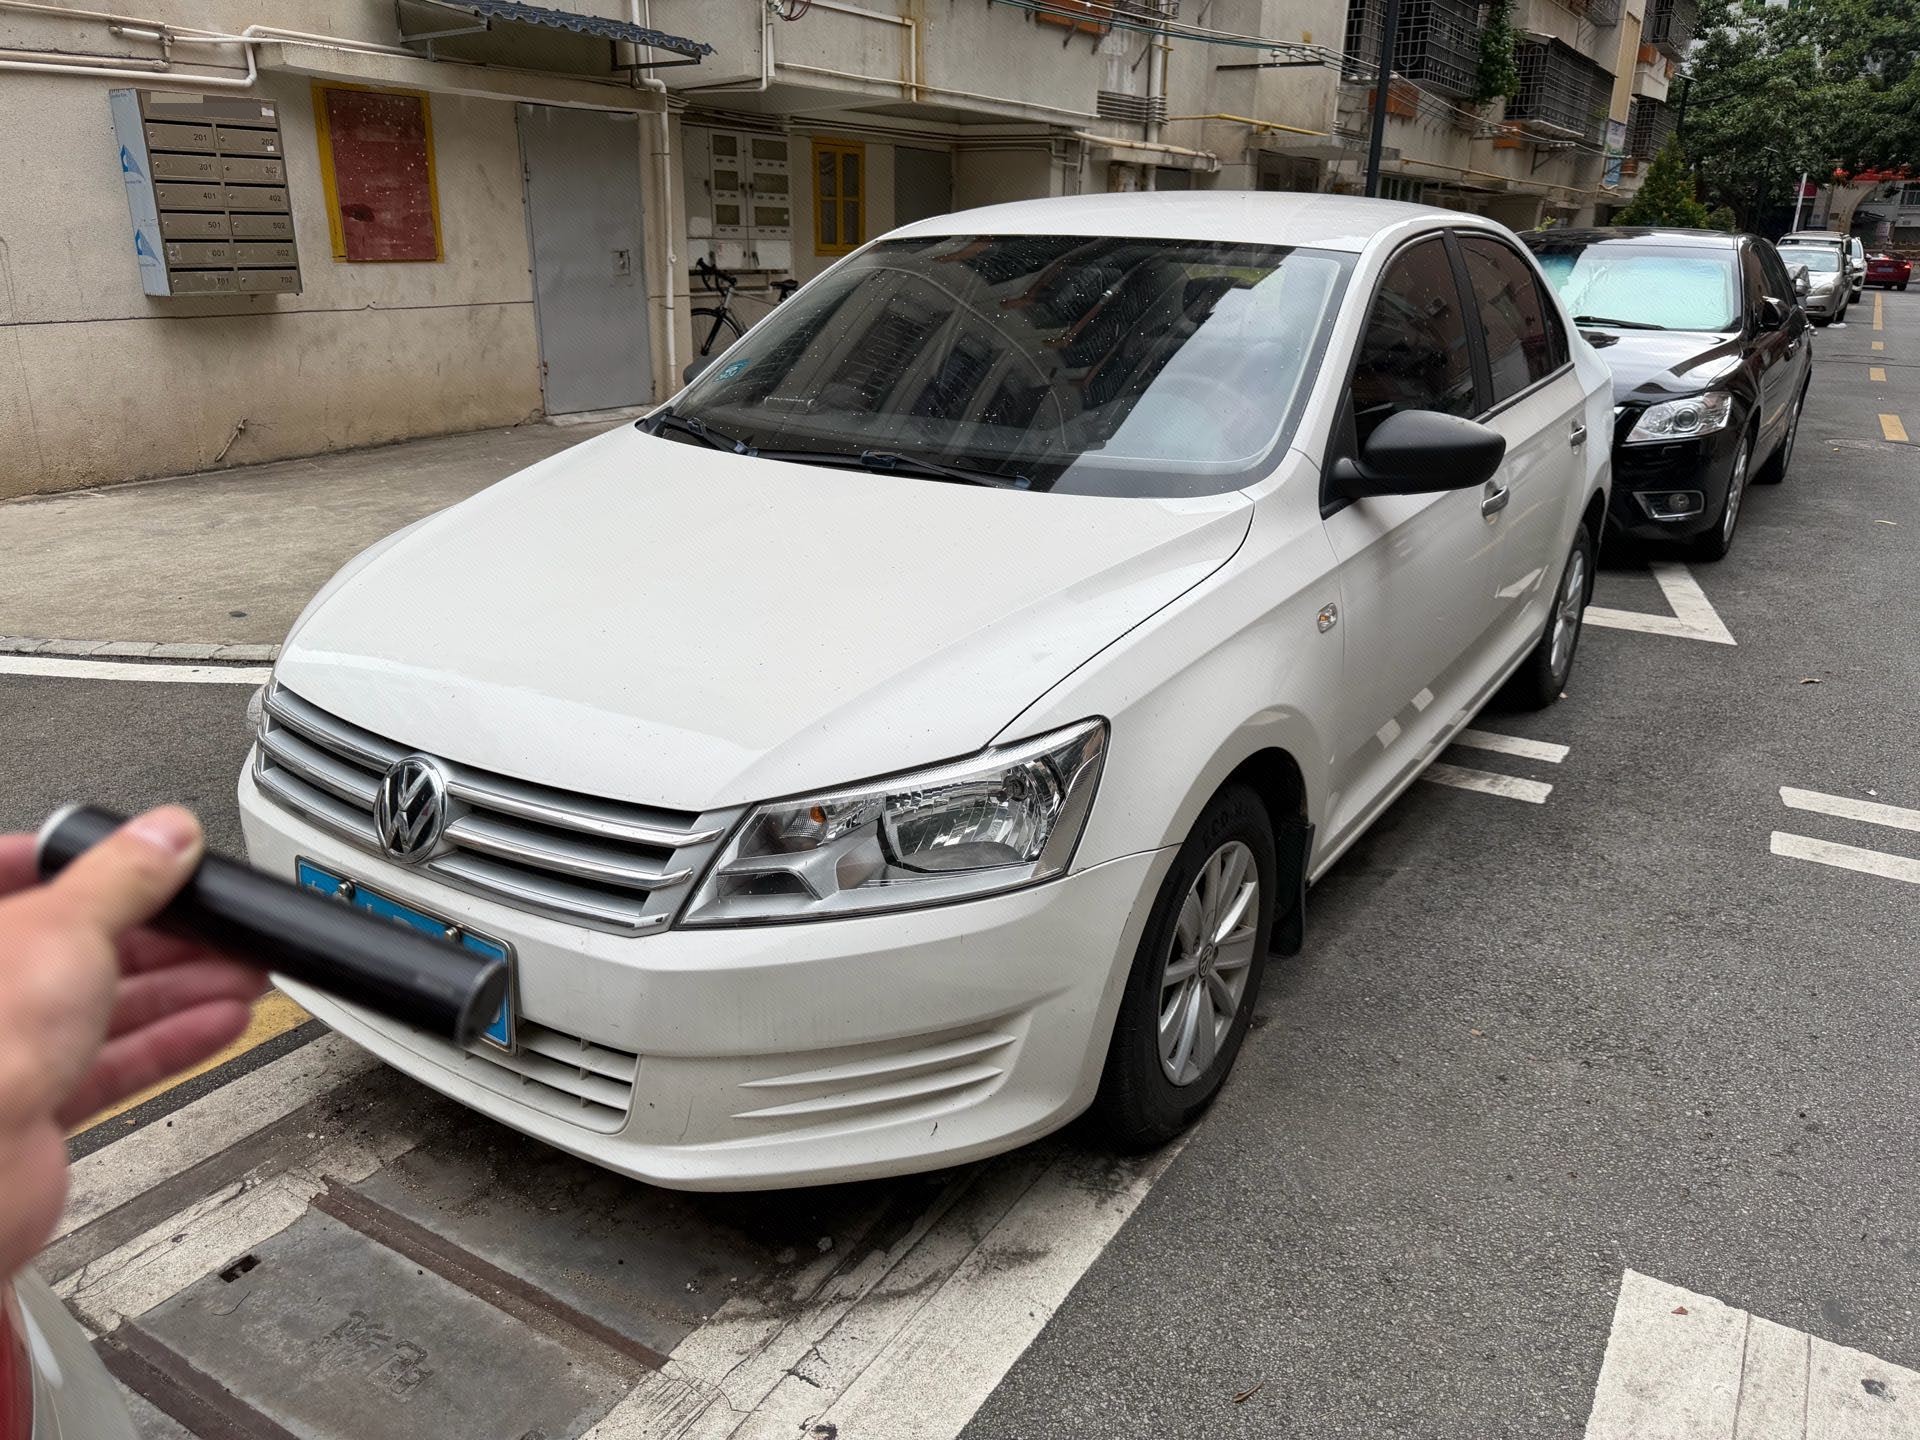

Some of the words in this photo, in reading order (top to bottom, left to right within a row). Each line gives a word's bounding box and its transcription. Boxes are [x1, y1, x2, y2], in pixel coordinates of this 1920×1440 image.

[193, 133, 207, 141] 201
[261, 138, 274, 146] 202
[199, 163, 212, 171] 301
[265, 166, 278, 174] 302
[203, 192, 216, 200] 401
[269, 194, 282, 202] 402
[208, 221, 221, 229] 501
[216, 277, 229, 285] 701
